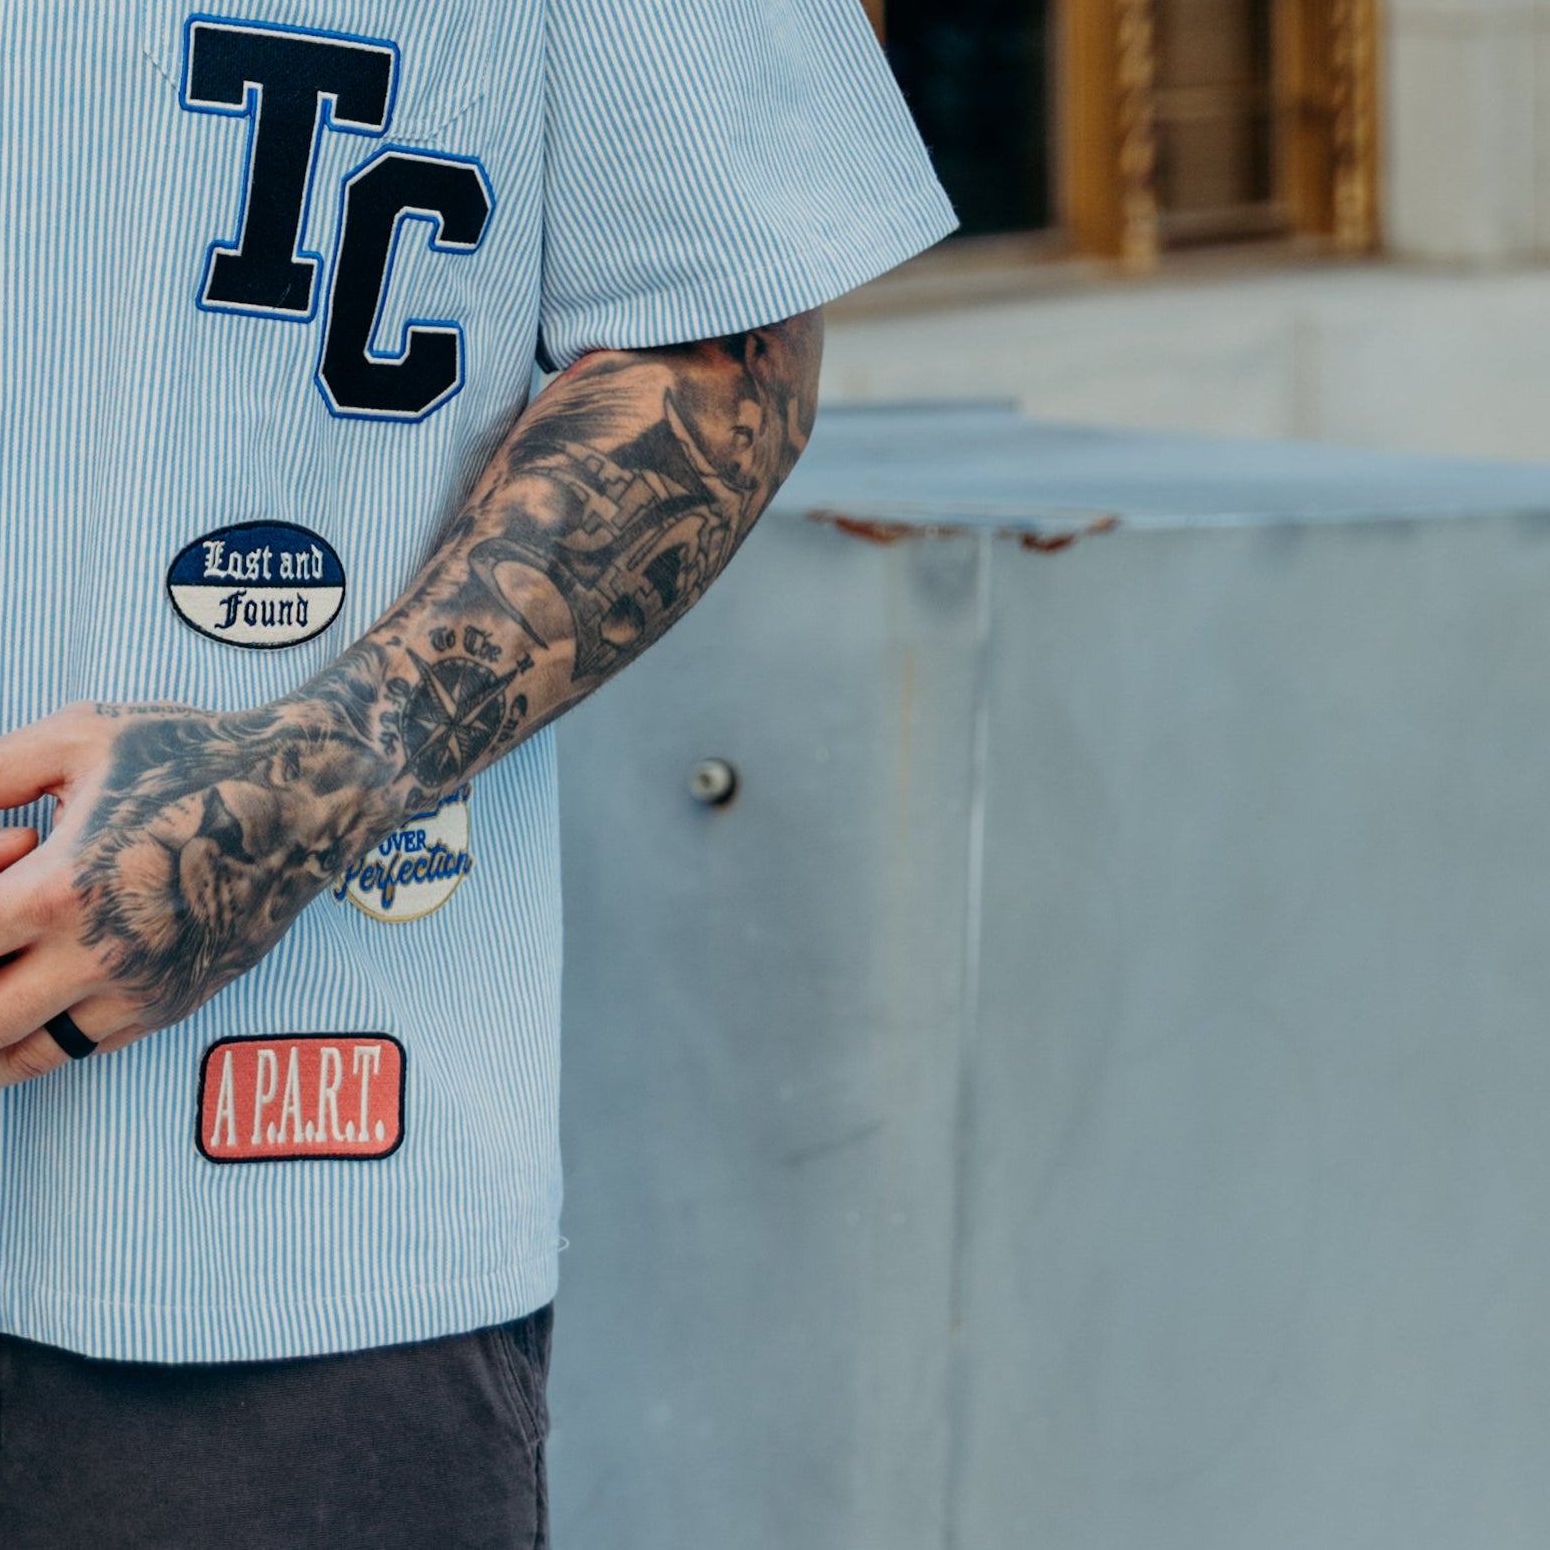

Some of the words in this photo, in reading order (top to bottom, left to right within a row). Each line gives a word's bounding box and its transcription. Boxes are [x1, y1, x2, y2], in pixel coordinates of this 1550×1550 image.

[202, 540, 273, 581] Lost
[279, 543, 324, 580] and
[214, 589, 310, 630] Found
[210, 1050, 237, 1148] A
[251, 1045, 386, 1146] P.A.R.T.
